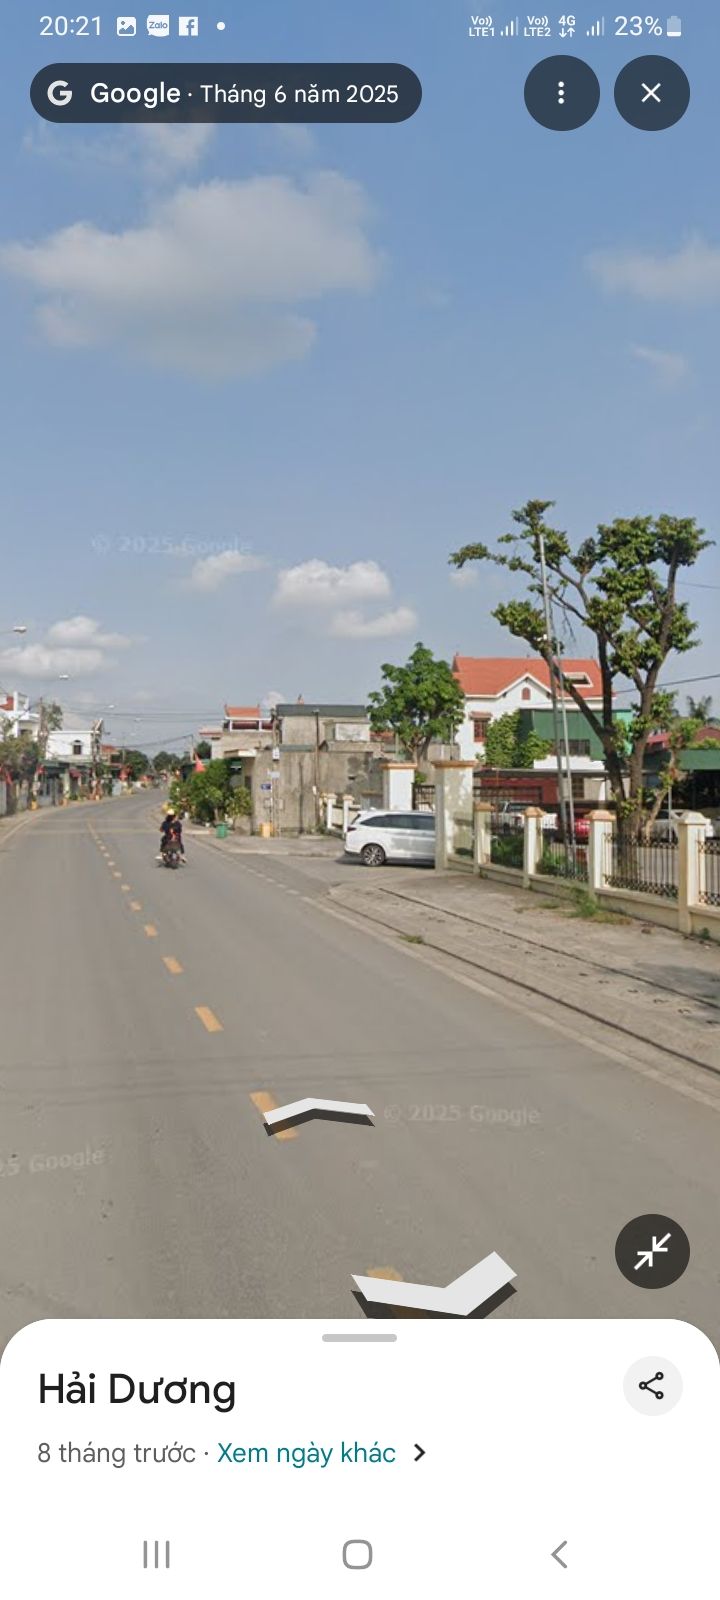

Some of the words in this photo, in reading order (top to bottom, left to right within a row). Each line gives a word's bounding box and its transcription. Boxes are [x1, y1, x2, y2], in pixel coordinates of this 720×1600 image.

[39, 15, 101, 36] 20:21
[148, 21, 168, 29] Zalo
[558, 15, 576, 26] 4G
[614, 15, 663, 36] 23%
[468, 27, 495, 37] LTE1
[524, 27, 551, 37] LTE2
[90, 82, 181, 109] Google
[200, 84, 266, 109] Tháng
[274, 84, 287, 104] 6
[294, 83, 340, 104] năm
[346, 84, 399, 104] 2025
[38, 1370, 97, 1405] Hải
[109, 1373, 236, 1413] Dương
[37, 1442, 51, 1463] 8
[58, 1441, 126, 1469] tháng
[134, 1440, 196, 1463] trước
[217, 1442, 268, 1463] Xem
[277, 1441, 334, 1469] ngày
[341, 1441, 396, 1463] khác
